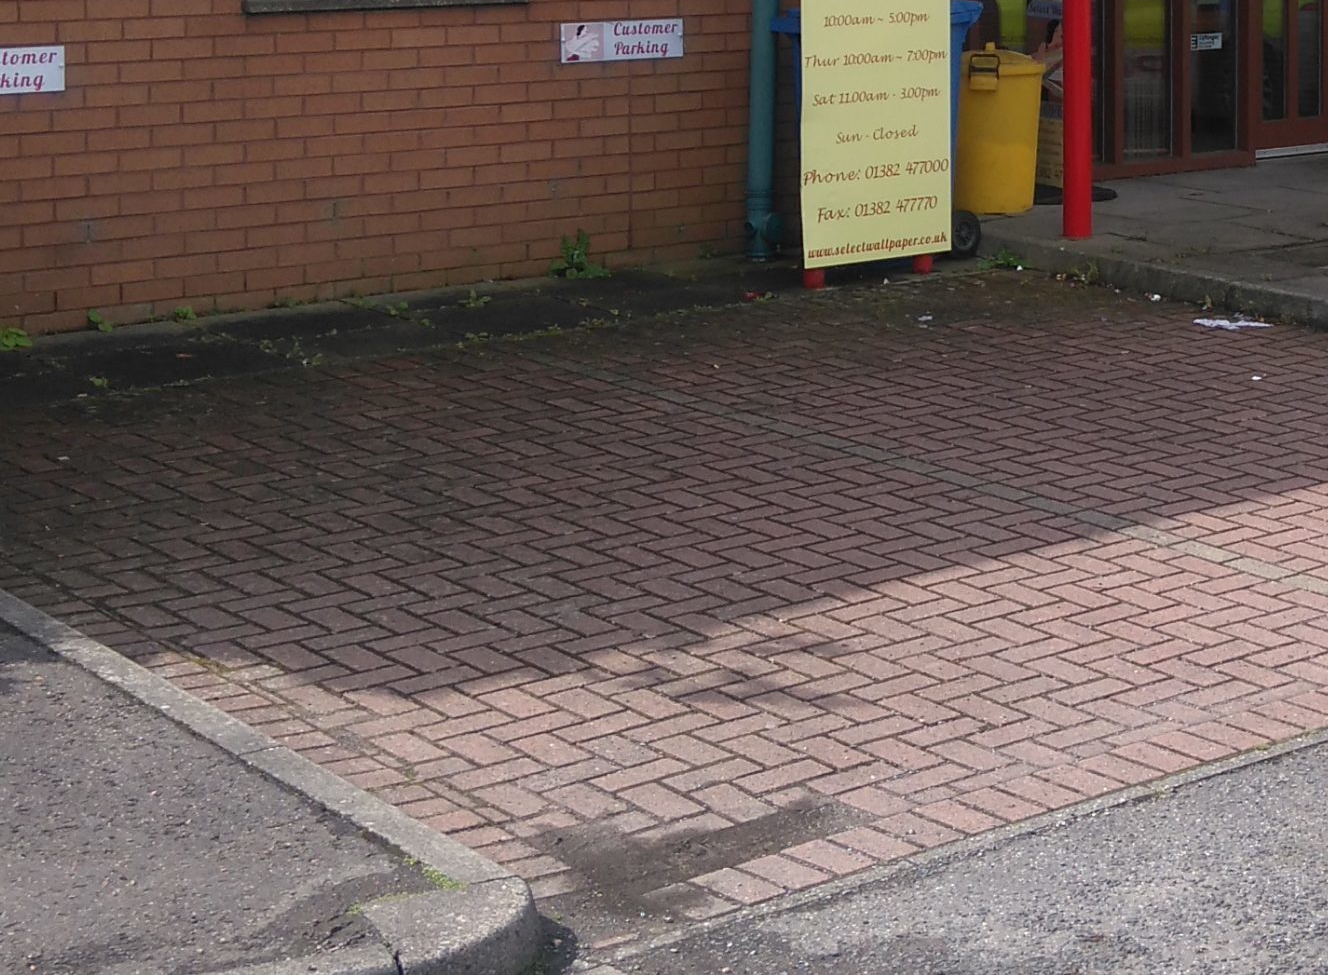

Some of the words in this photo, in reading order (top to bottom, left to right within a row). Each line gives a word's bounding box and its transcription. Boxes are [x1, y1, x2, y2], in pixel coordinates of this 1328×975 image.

[613, 22, 678, 36] Customer
[614, 41, 669, 56] Parking
[1, 51, 58, 66] tomer
[805, 55, 839, 68] Thur
[0, 72, 45, 91] king
[813, 93, 836, 107] Sat
[836, 131, 863, 144] Sun
[873, 124, 919, 141] Closed
[803, 169, 862, 186] Phone:
[865, 162, 901, 179] 01382
[905, 158, 949, 176] 477000
[817, 206, 851, 224] Fax:
[854, 200, 891, 217] 01382
[896, 195, 938, 213] 477770
[807, 231, 948, 259] www.selectwallpaper.co.uk
